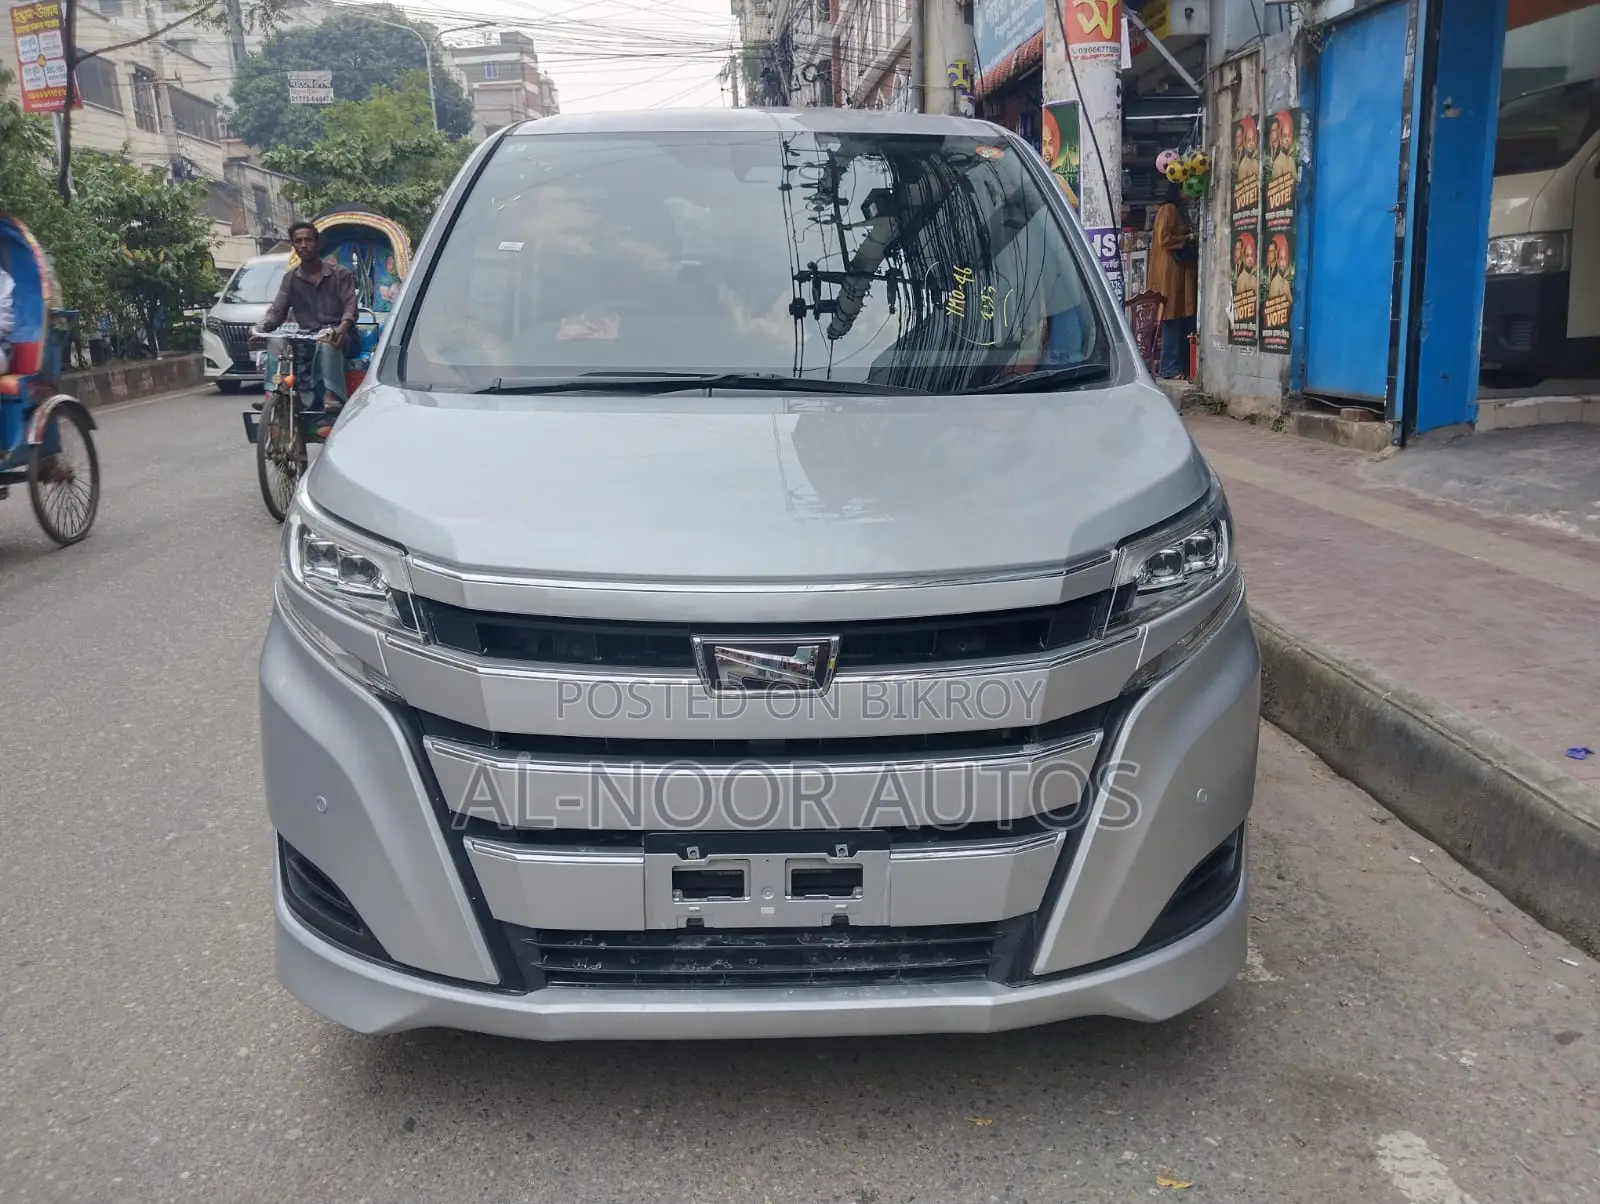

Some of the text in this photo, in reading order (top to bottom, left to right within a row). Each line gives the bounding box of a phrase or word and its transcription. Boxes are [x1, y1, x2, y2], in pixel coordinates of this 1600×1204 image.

[1236, 187, 1258, 210] VOTE!
[1269, 187, 1292, 209] VOTE!
[1234, 302, 1255, 321] VOTE!
[1267, 308, 1288, 328] VOTE!
